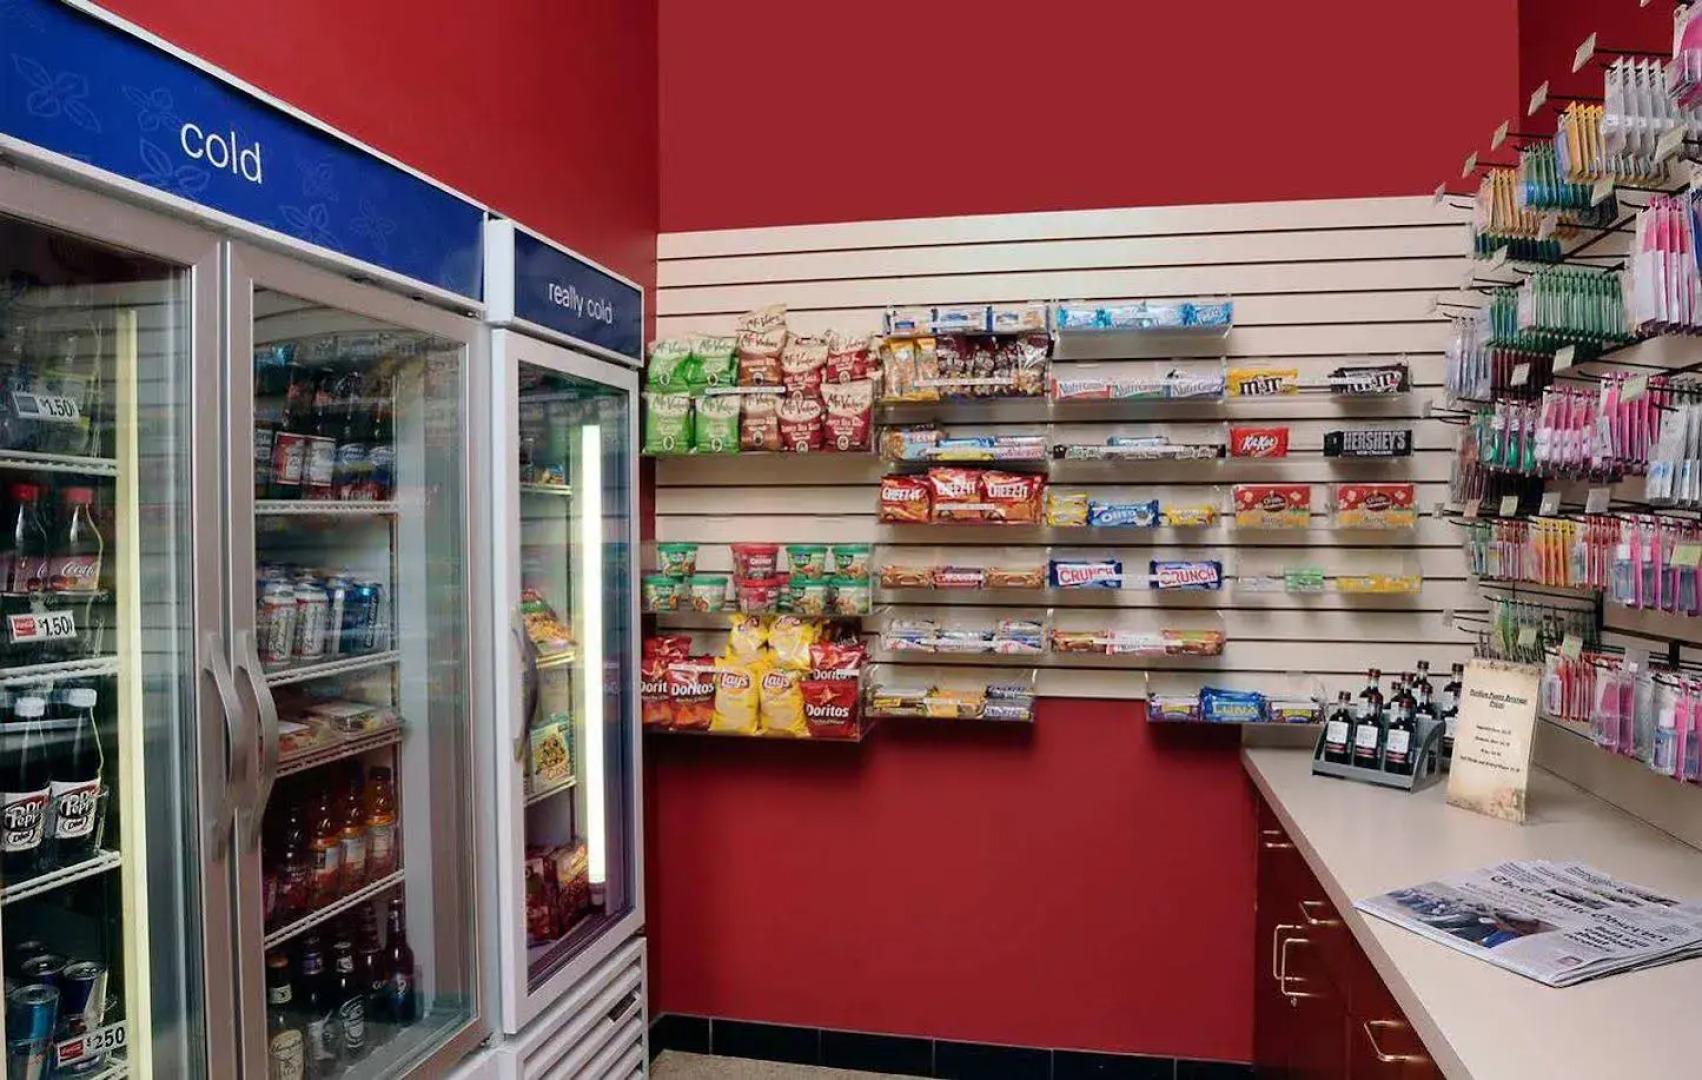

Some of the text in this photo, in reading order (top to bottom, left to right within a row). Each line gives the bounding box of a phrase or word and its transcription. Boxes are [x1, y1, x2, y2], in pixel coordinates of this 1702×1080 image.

[181, 123, 262, 184] cold
[549, 283, 613, 325] really cold
[1343, 431, 1406, 450] HERSHEY'S
[1060, 567, 1115, 583] CRUNCH
[1160, 569, 1216, 585] CRUNCH
[671, 682, 715, 696] Doritos
[806, 703, 849, 717] Doritos
